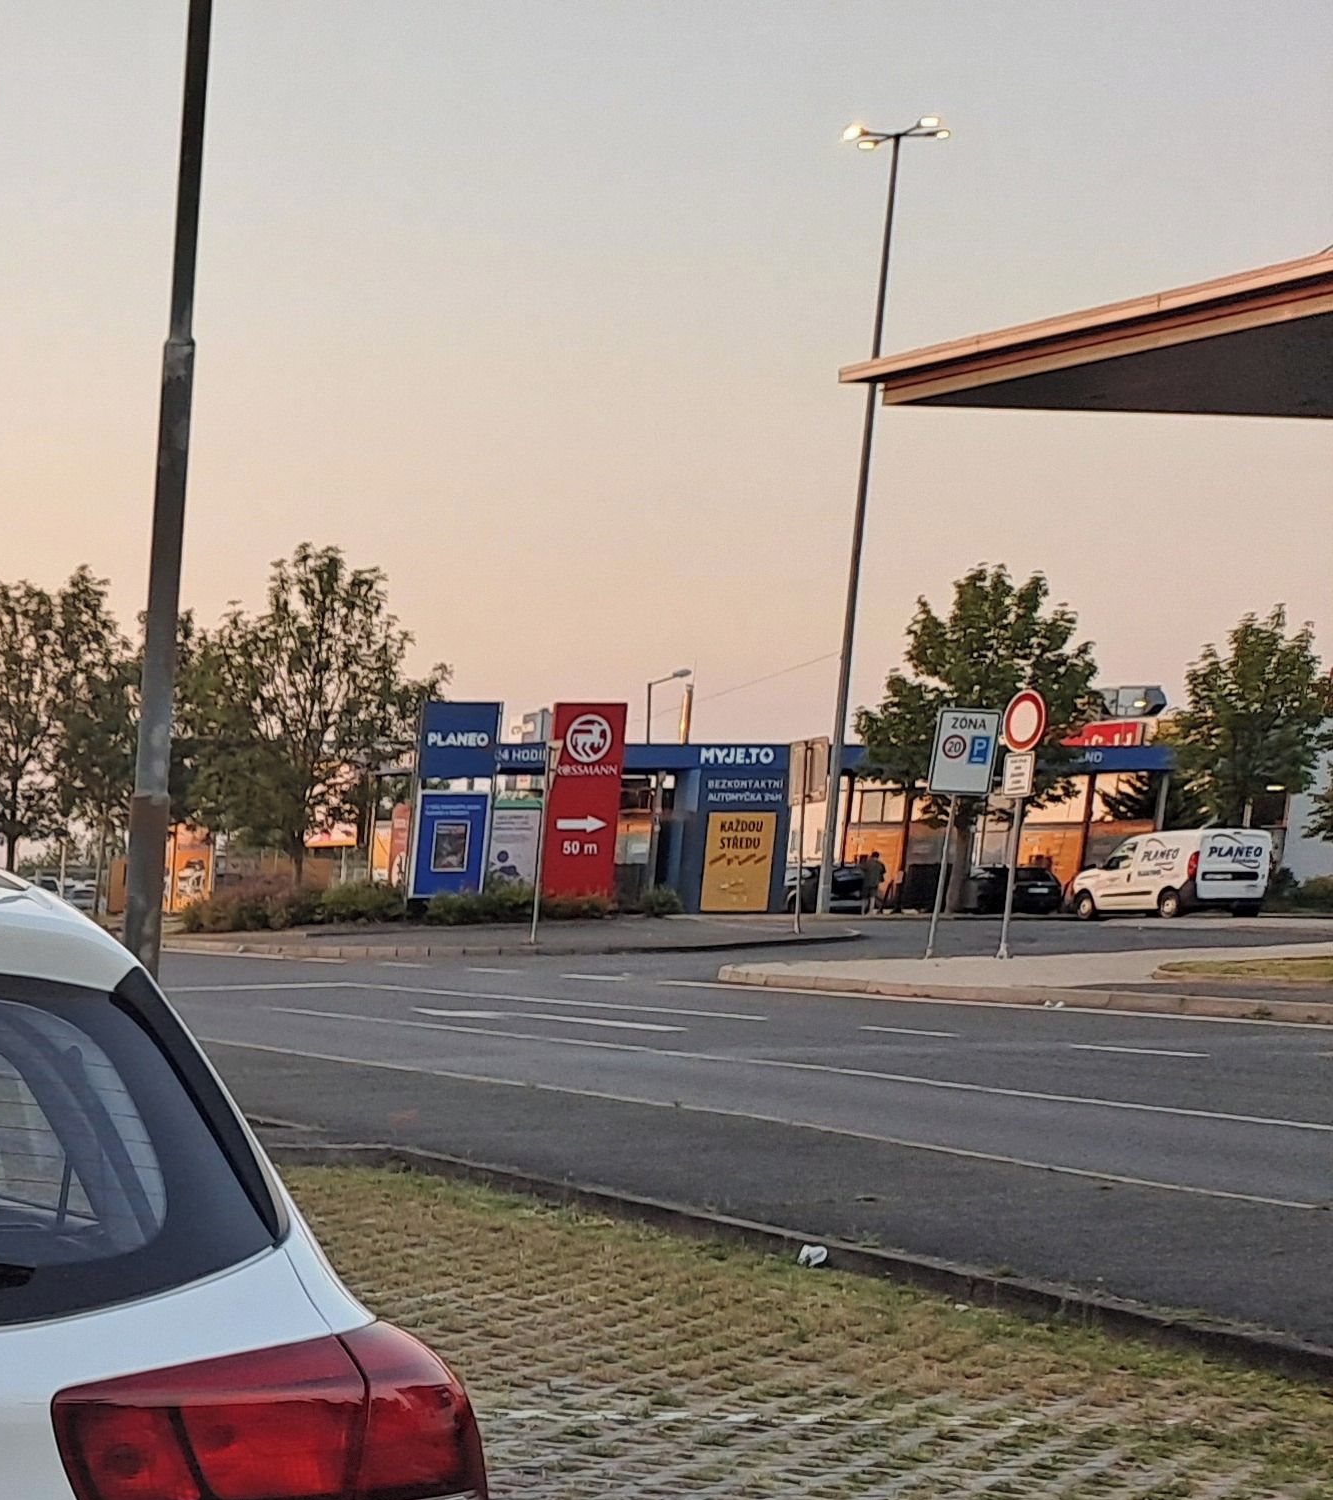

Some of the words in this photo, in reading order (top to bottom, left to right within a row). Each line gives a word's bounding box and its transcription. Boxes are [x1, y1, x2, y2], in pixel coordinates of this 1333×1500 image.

[427, 732, 489, 747] PLANEO
[947, 741, 962, 753] 20
[700, 747, 775, 765] MYJE.TO
[720, 818, 764, 833] KAŽDOU
[562, 841, 580, 855] 50
[583, 843, 598, 855] m
[719, 834, 761, 850] STŘEDU
[1141, 848, 1180, 862] PLANEO
[1207, 846, 1263, 861] PLANEO
